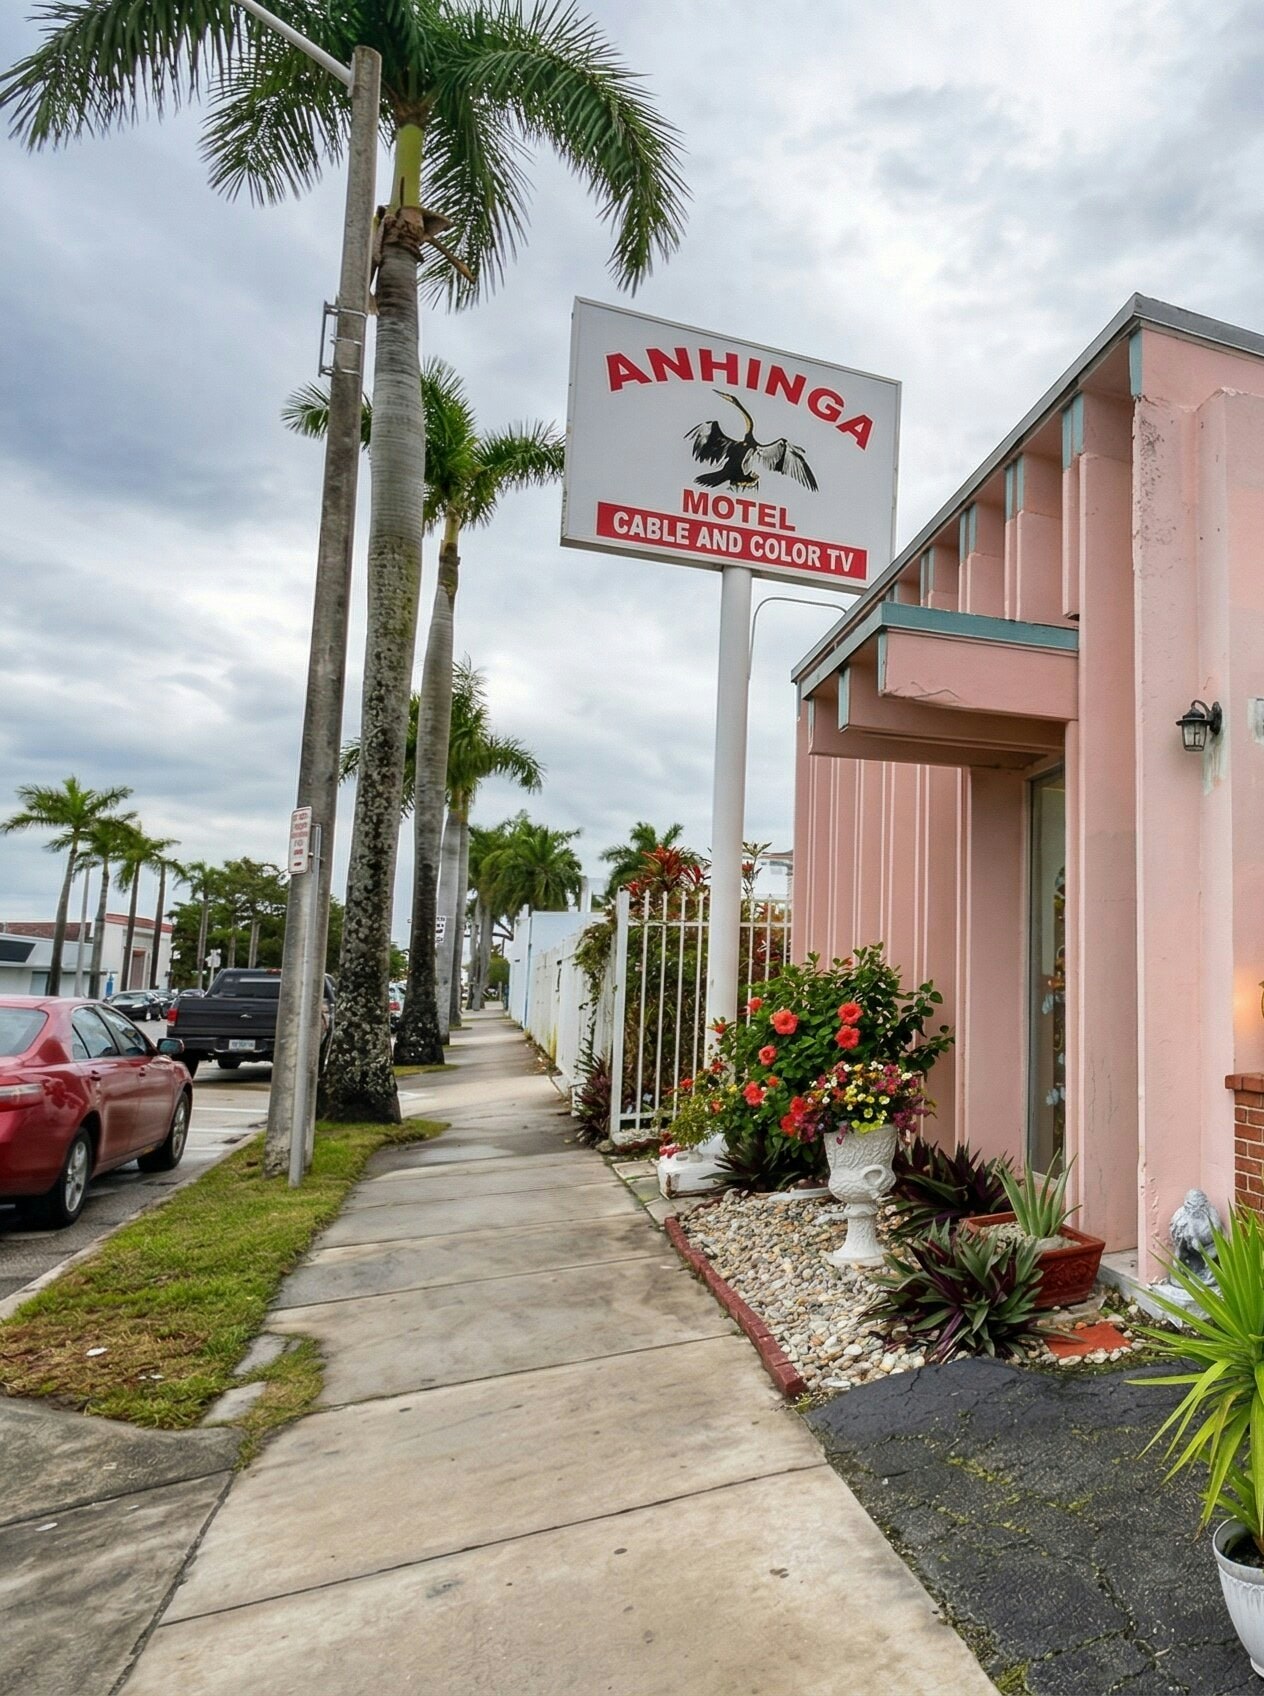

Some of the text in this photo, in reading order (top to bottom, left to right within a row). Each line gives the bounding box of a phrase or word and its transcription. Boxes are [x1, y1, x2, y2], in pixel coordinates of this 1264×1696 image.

[605, 347, 875, 451] ANHINGA
[682, 489, 796, 532] MOTEL
[612, 511, 854, 573] CABLE AND COLOR TV
